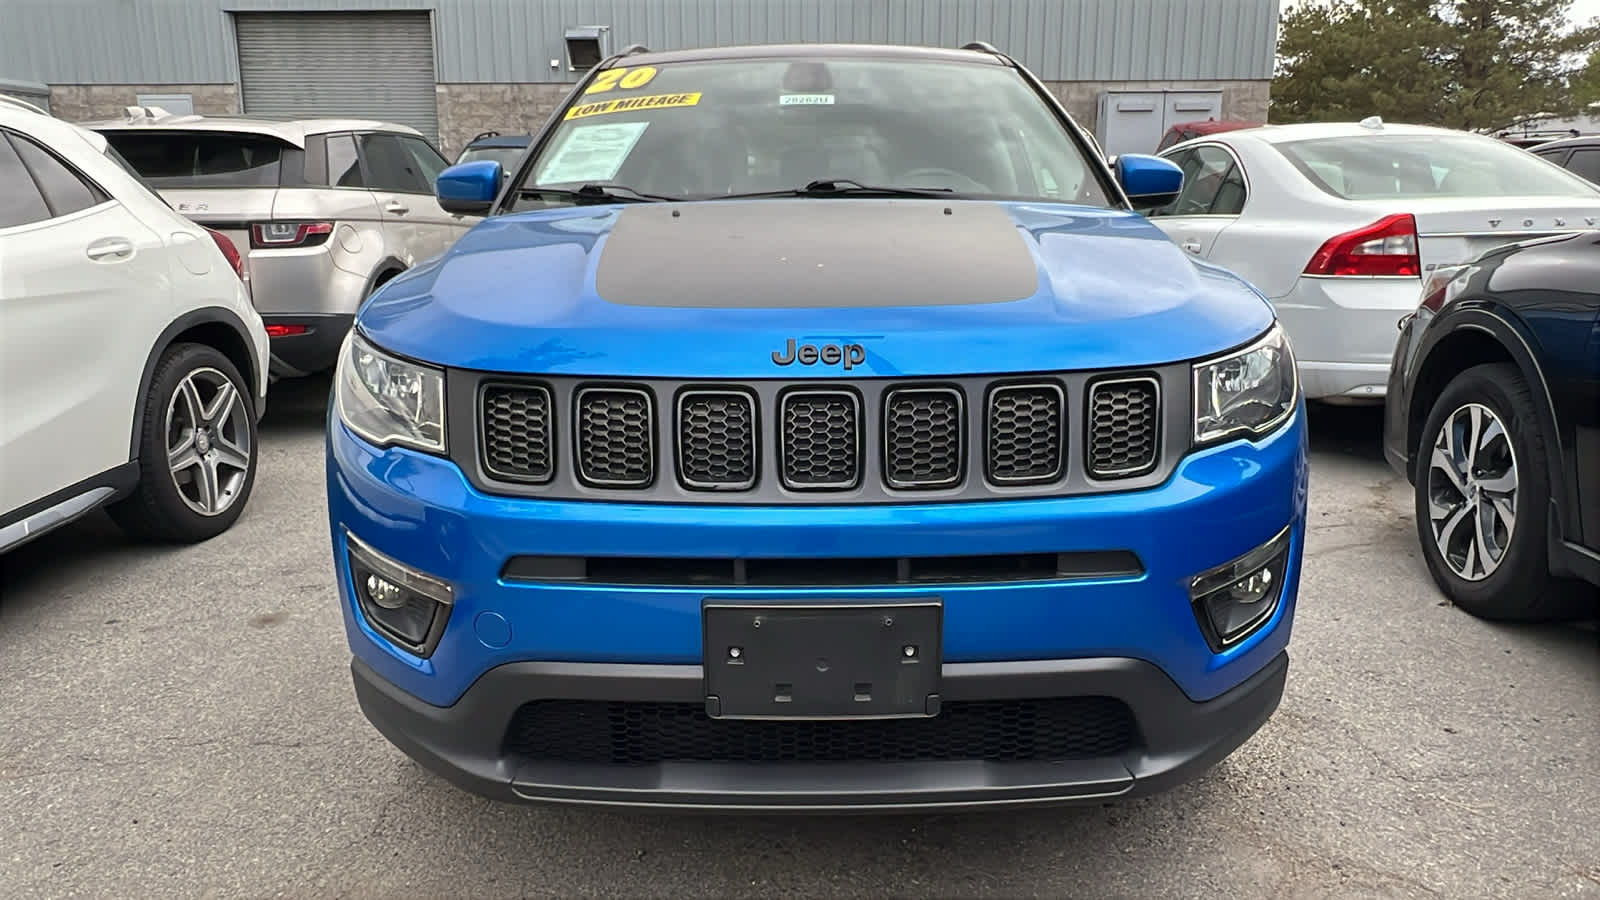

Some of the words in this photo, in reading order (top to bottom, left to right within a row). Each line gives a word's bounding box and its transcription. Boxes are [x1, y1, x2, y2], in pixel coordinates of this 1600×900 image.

[584, 66, 657, 95] 20
[572, 102, 612, 117] LOW
[613, 95, 691, 110] MILEAGE
[771, 338, 865, 371] Jeep
